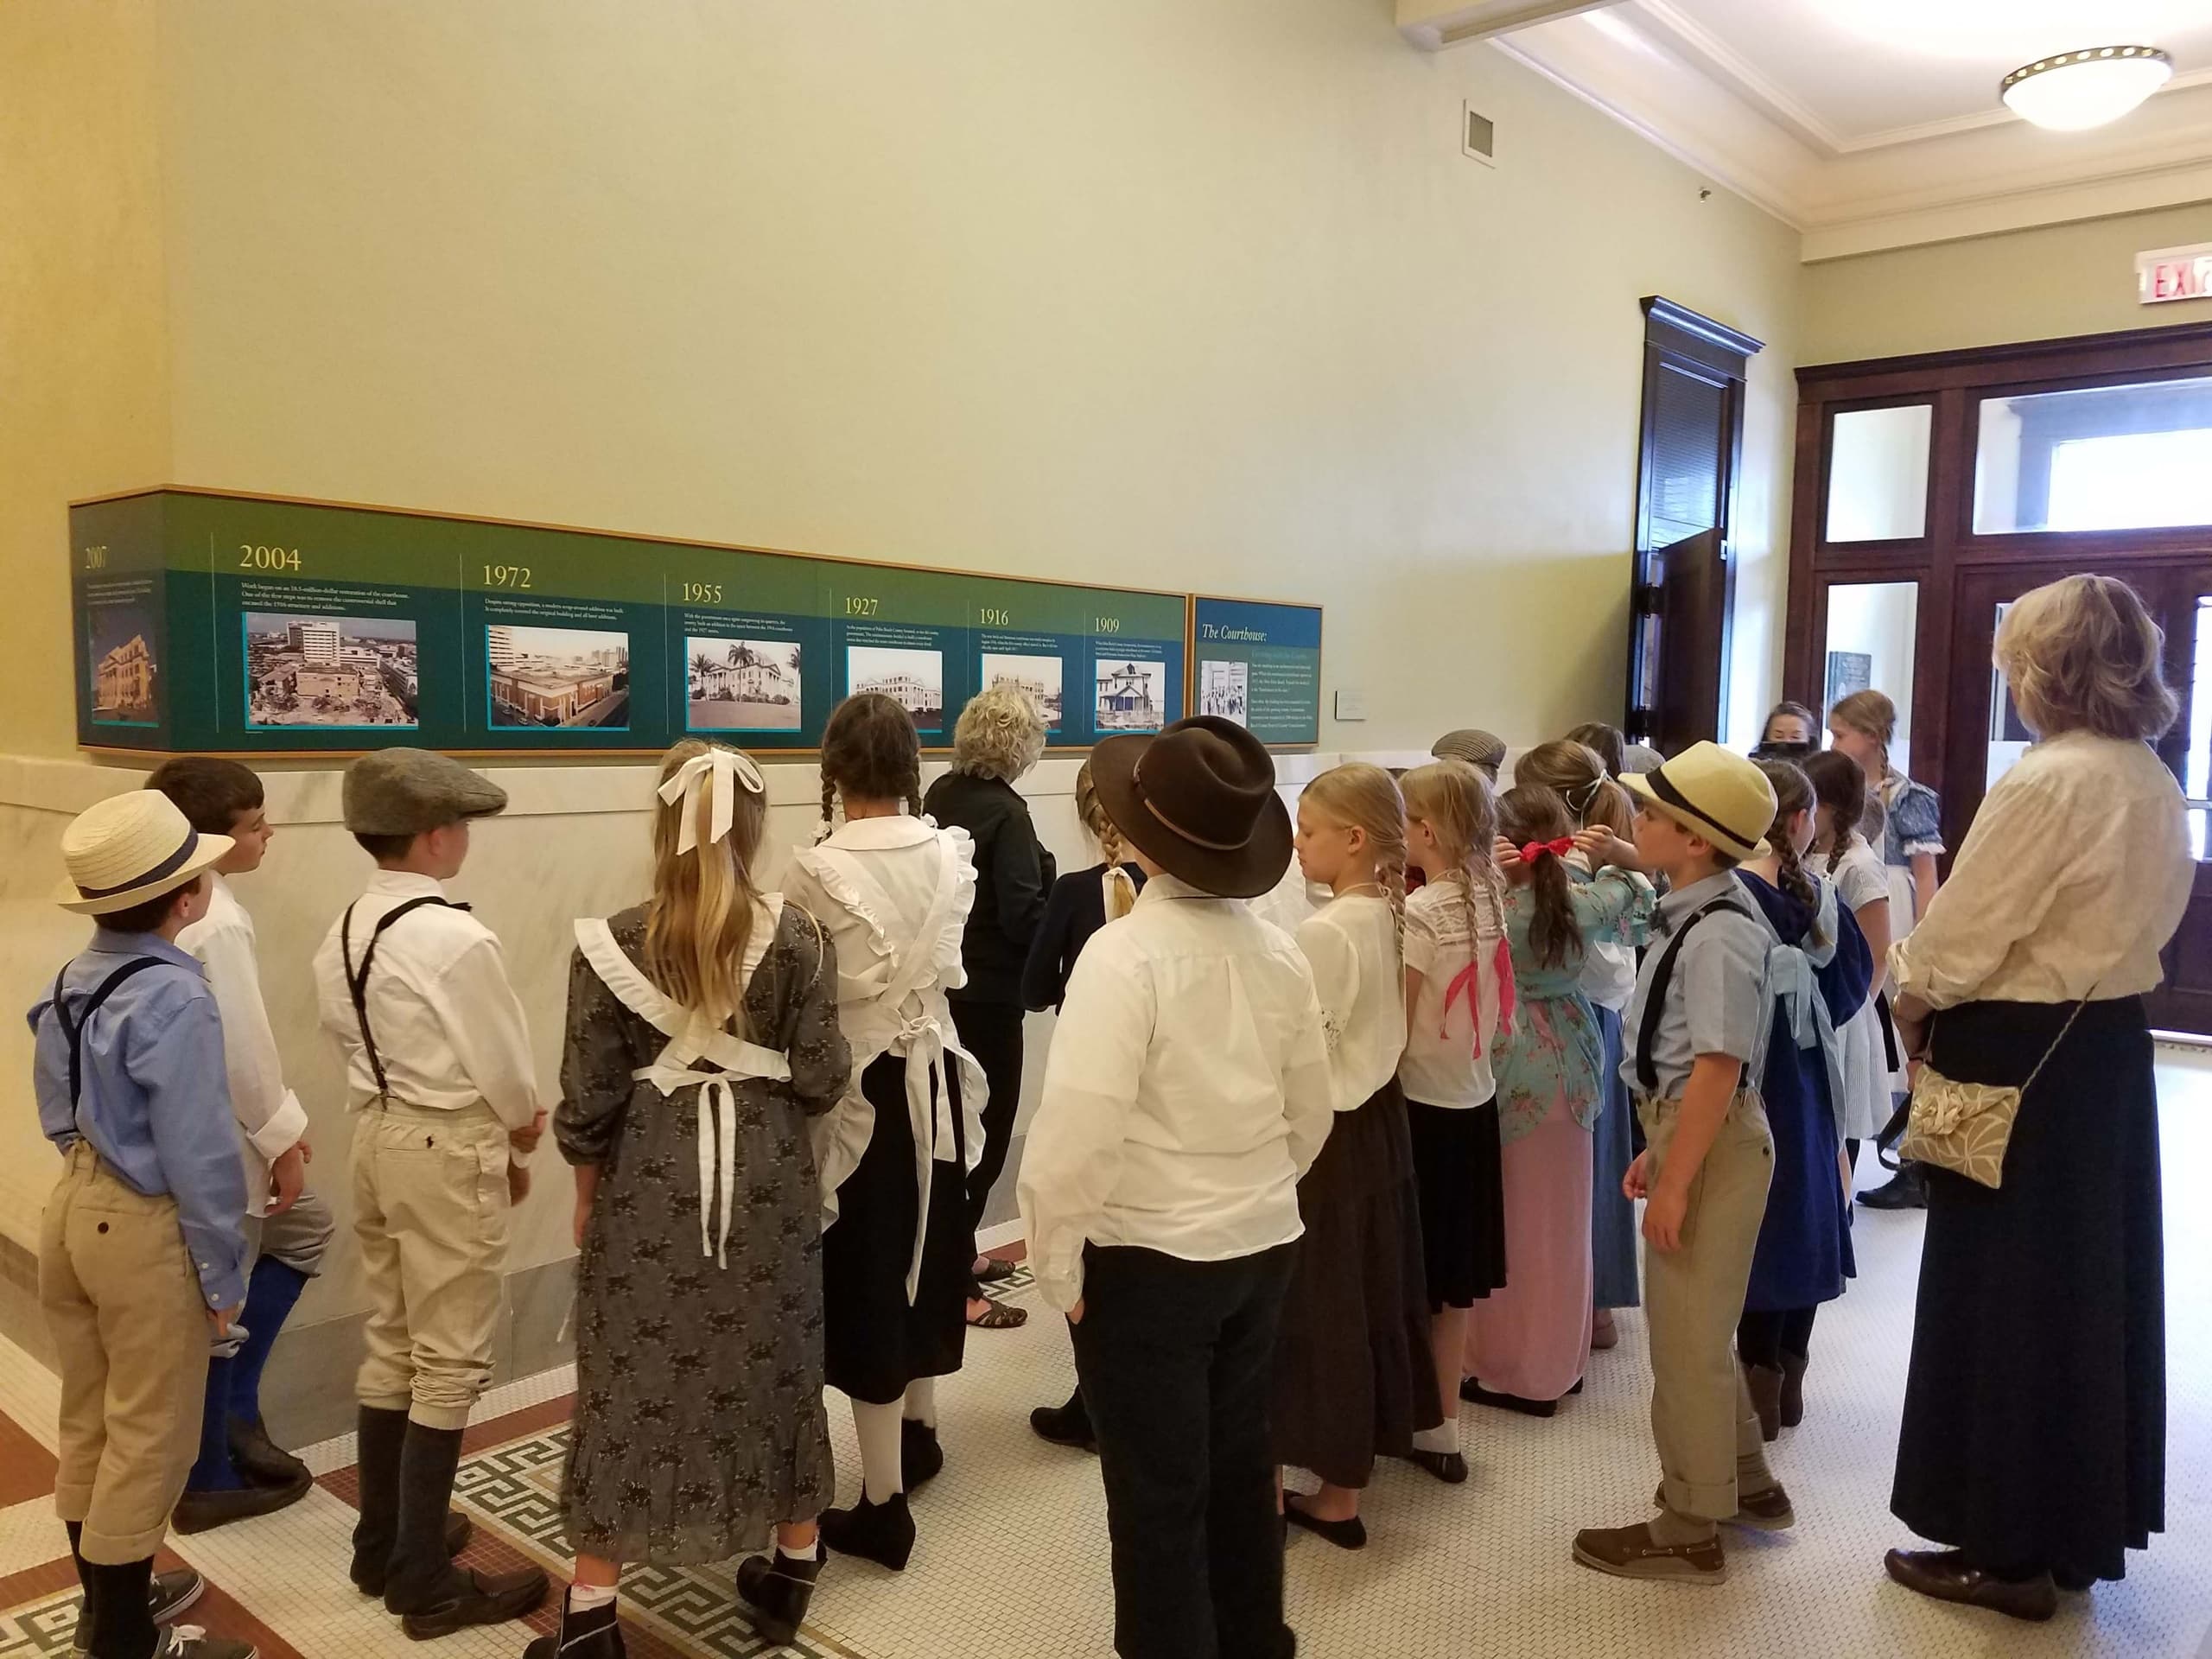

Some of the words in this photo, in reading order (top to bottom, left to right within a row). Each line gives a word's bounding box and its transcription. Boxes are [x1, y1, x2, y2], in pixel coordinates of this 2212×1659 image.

[2155, 261, 2212, 298] EXI
[239, 544, 302, 571] 2004
[483, 564, 531, 588] 1972
[683, 582, 722, 604] 1955
[846, 596, 879, 616] 1927
[981, 608, 1009, 626] 1916
[1095, 616, 1120, 633] 1909
[1202, 623, 1219, 639] The
[1220, 624, 1268, 642] Courthouse:
